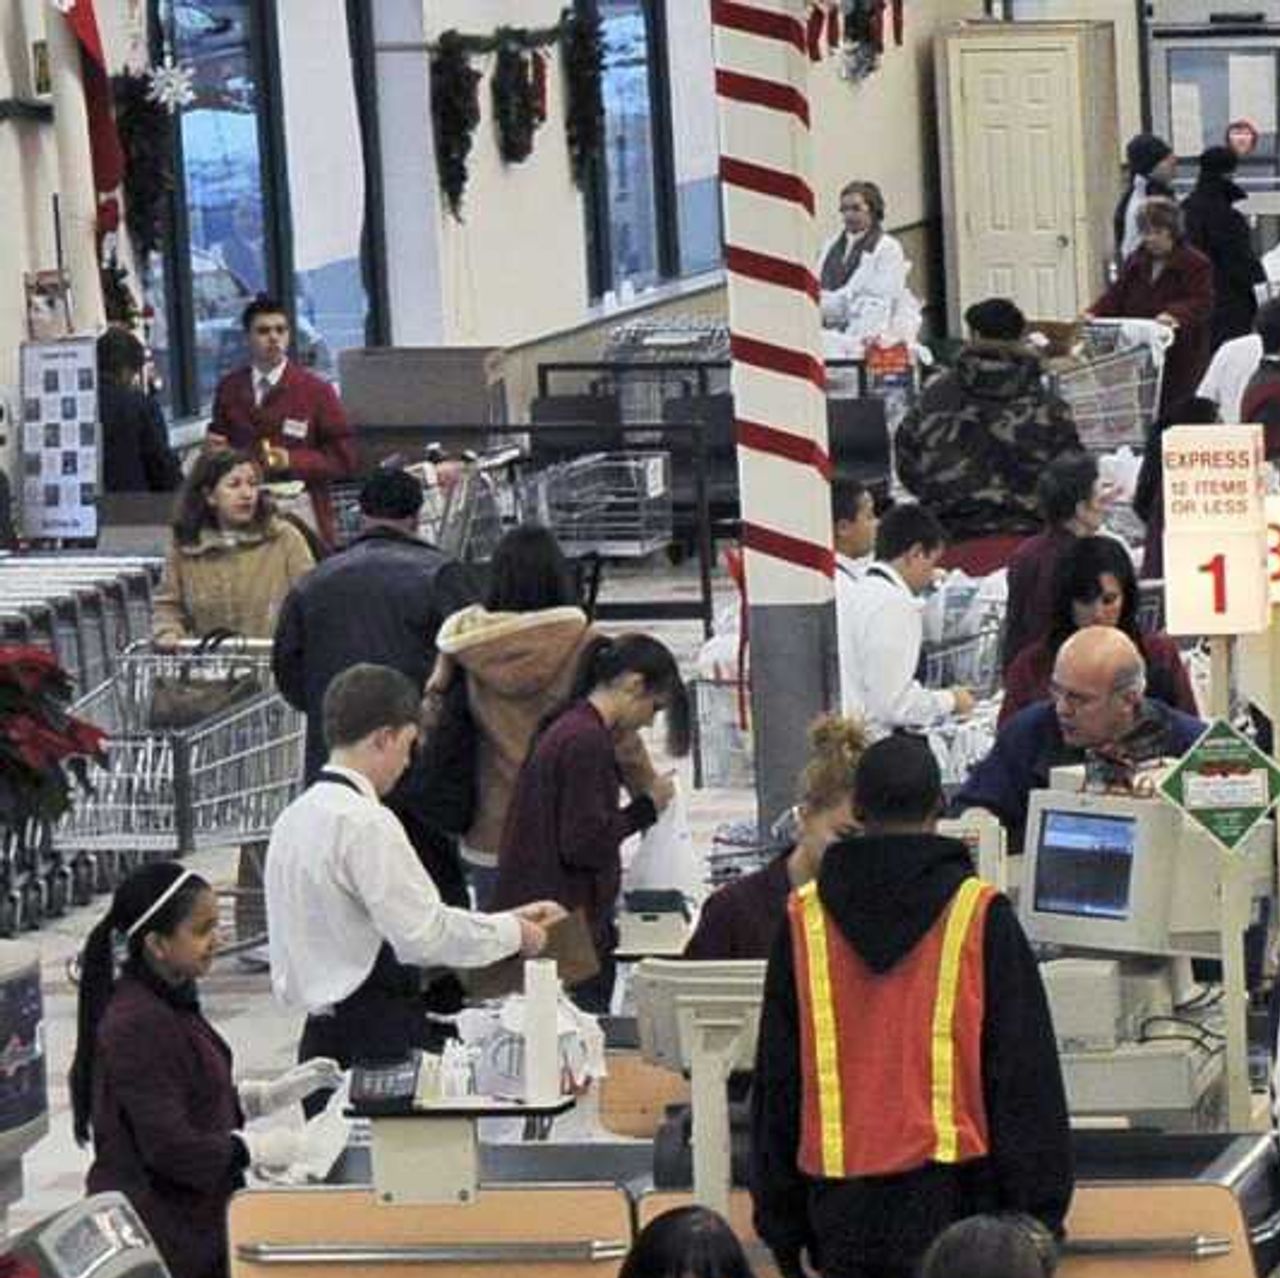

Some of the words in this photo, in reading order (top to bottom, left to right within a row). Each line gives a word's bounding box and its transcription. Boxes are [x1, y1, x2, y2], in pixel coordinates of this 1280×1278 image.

[1164, 451, 1250, 470] EXPRESS
[1193, 479, 1248, 496] ITEMS
[1202, 501, 1248, 516] LESS
[1198, 553, 1226, 615] 1
